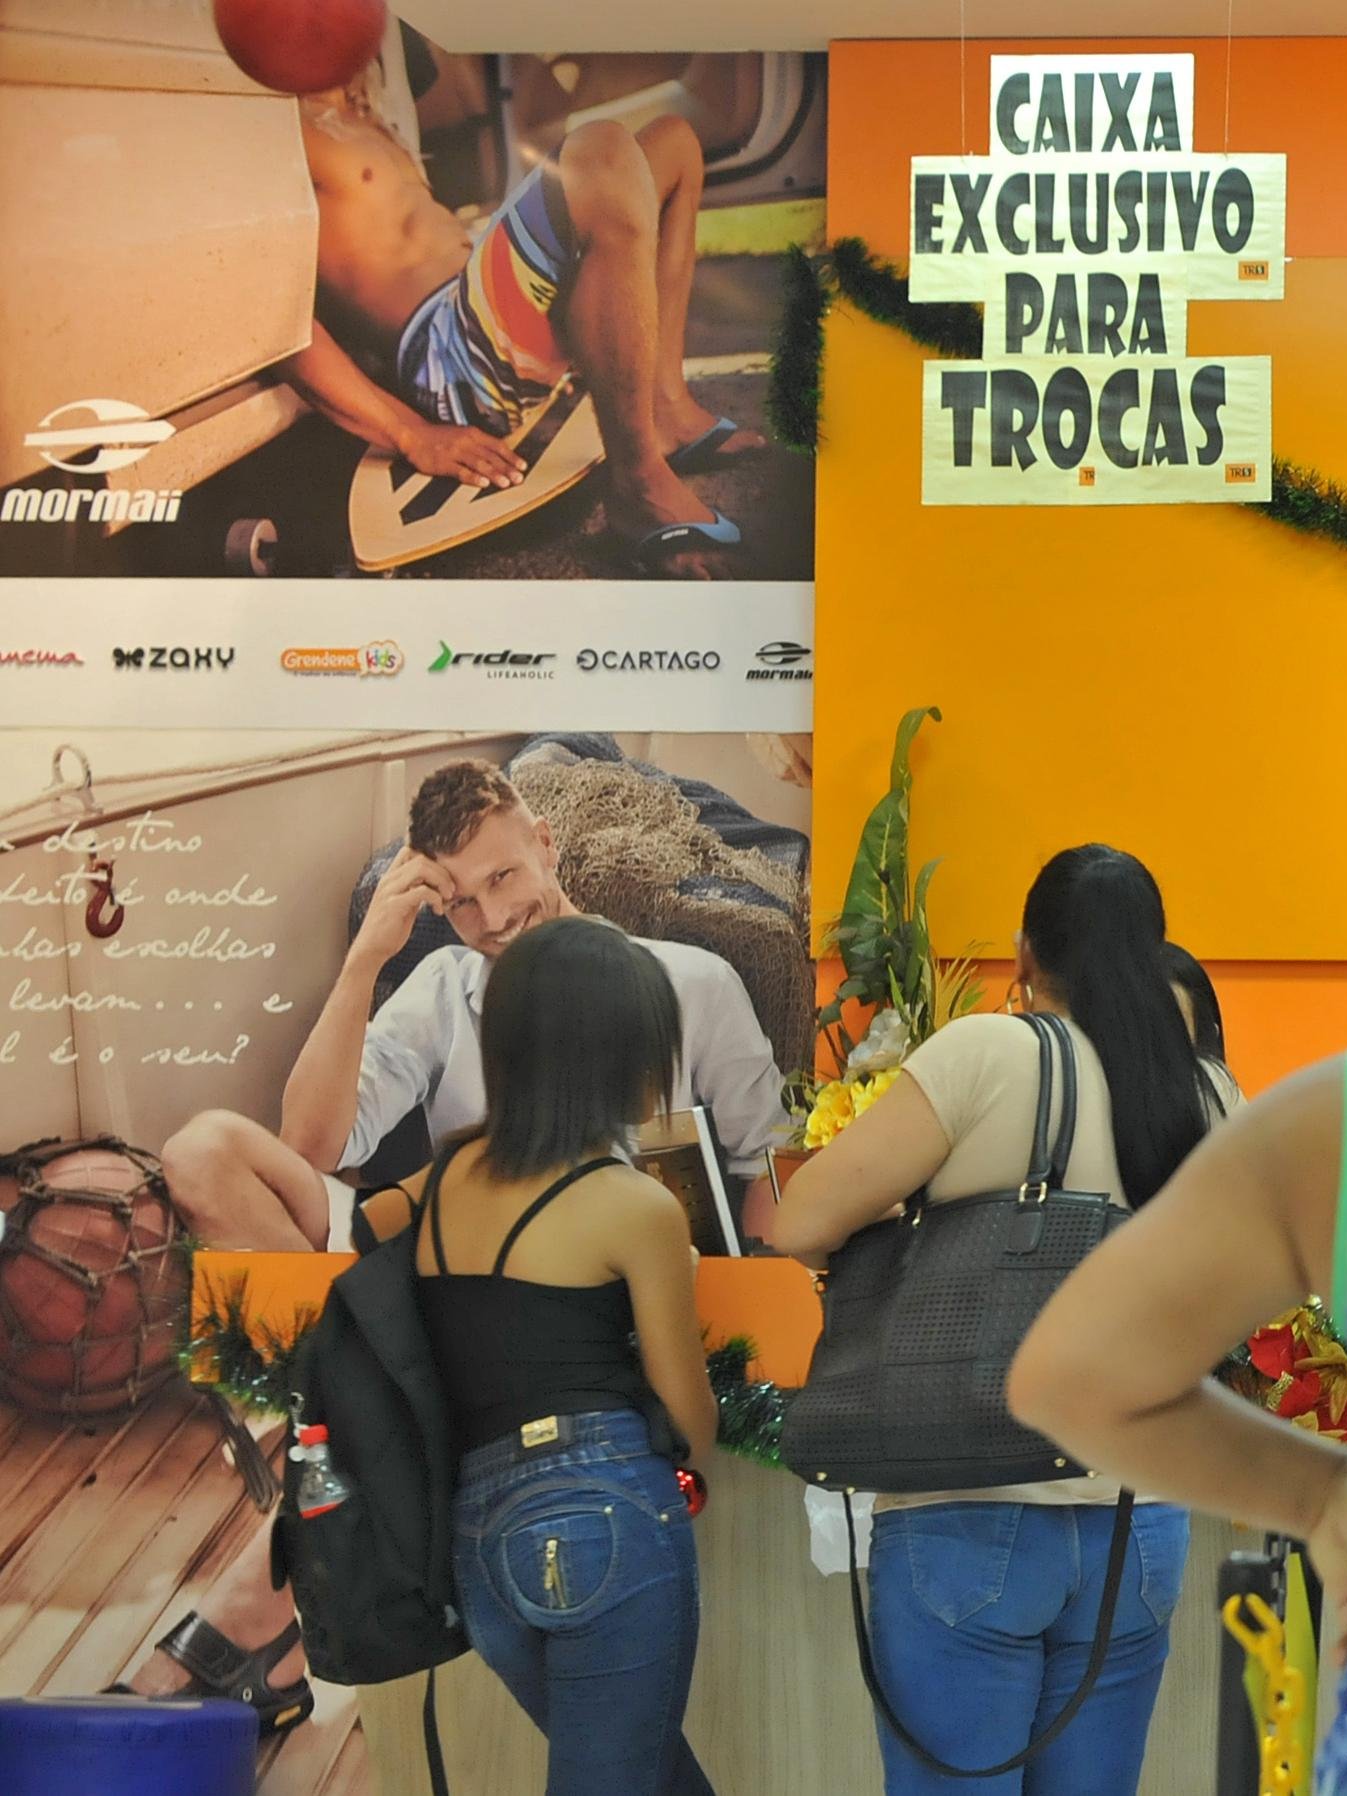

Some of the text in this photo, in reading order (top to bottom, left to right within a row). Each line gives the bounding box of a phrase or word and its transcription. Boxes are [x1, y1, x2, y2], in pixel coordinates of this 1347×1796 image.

[996, 71, 1182, 156] CAIXA
[914, 167, 1255, 256] EXCLUSIVO
[1005, 271, 1168, 358] PARA
[940, 364, 1227, 470] TROCAS
[0, 487, 183, 523] mormaii
[0, 649, 84, 667] nema
[365, 647, 397, 669] kids
[452, 649, 557, 665] rider
[602, 650, 721, 669] CARTAGO
[487, 671, 555, 680] LIFEAHOLIC
[42, 810, 203, 852] destino
[114, 877, 145, 906] é
[164, 873, 278, 906] onde
[103, 926, 277, 962] escolhas
[262, 993, 294, 1013] e
[48, 1036, 79, 1064] é
[98, 1046, 115, 1063] o
[141, 1034, 250, 1065] seu?
